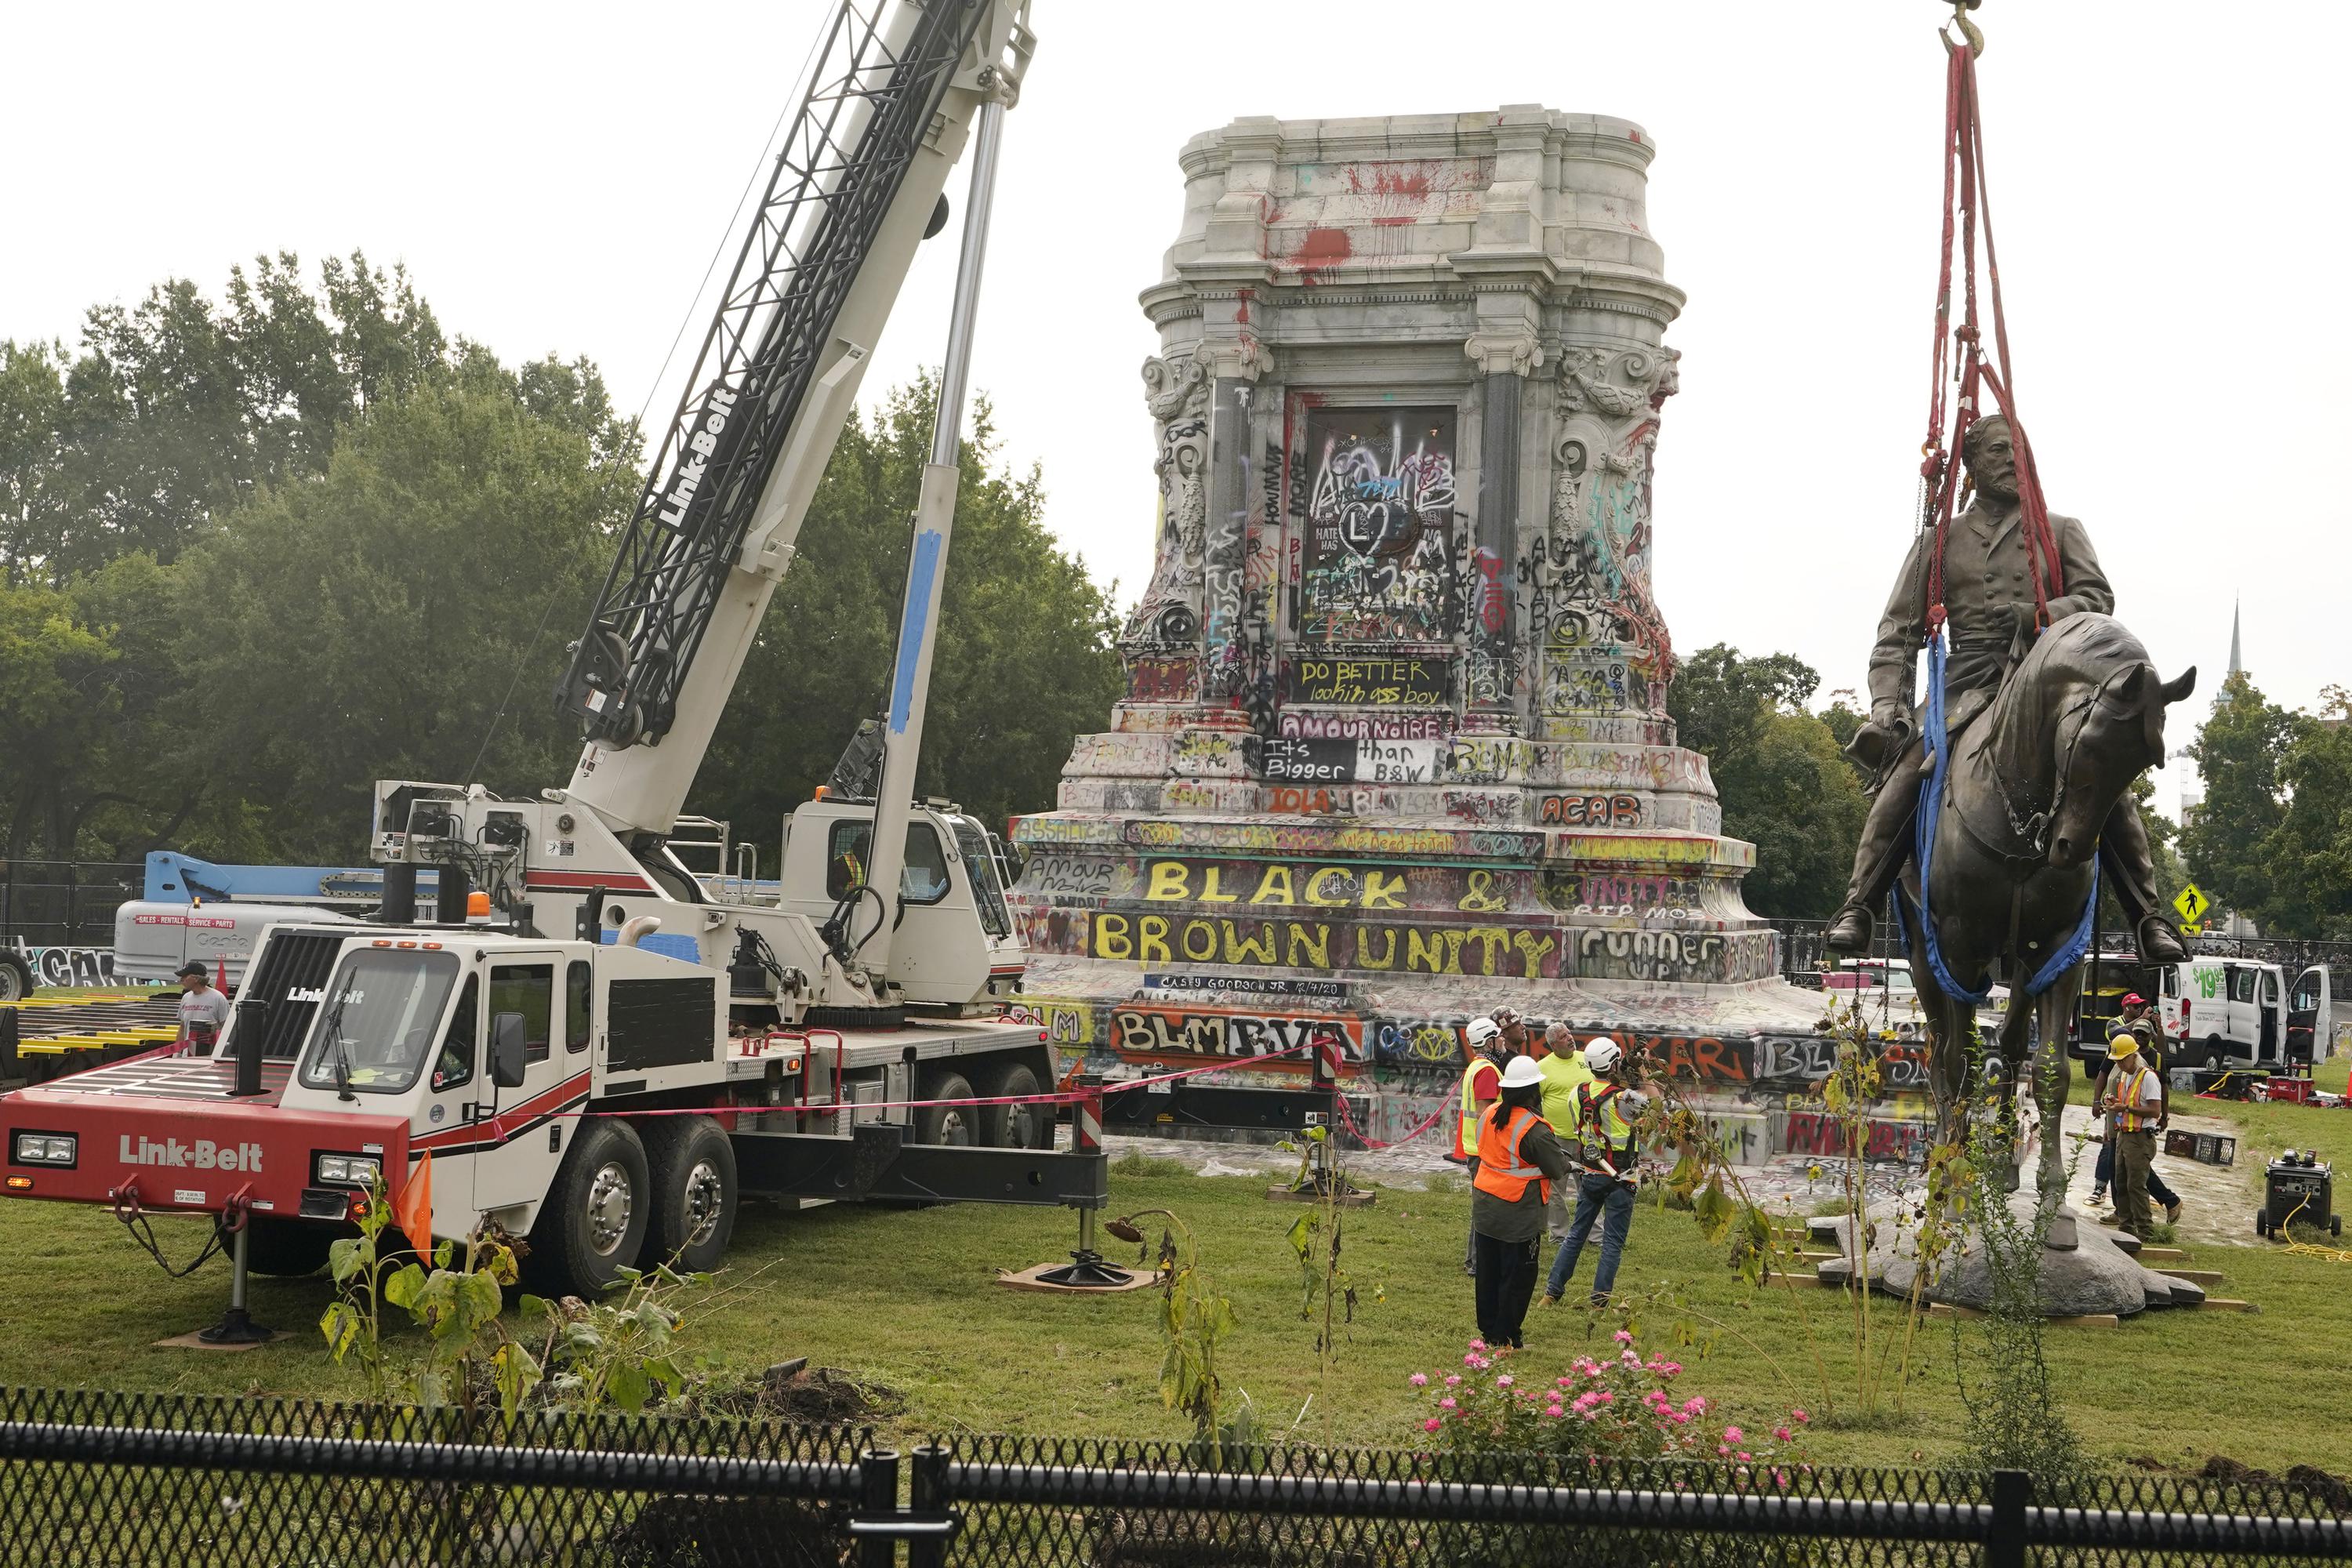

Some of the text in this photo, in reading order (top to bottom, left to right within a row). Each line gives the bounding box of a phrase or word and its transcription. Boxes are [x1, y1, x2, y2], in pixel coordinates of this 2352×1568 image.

[658, 387, 739, 528] Link-Belt
[1316, 528, 1338, 540] HATE
[1321, 539, 1338, 550] HAS
[1301, 660, 1430, 684] DO BETTER
[1370, 687, 1401, 704] ass
[1403, 683, 1440, 706] boy
[1280, 714, 1371, 739] AMOUR
[1264, 738, 1310, 757] It's
[1359, 740, 1414, 764] than
[1265, 757, 1345, 779] Bigger
[1374, 763, 1426, 782] B&W
[1267, 786, 1330, 813] IOLA
[1541, 796, 1641, 829] ACAB
[1341, 833, 1367, 850] We
[1410, 835, 1428, 850] to
[1029, 858, 1115, 883] AMOUR
[1145, 861, 1507, 913] BLACK &
[1581, 875, 1670, 904] UNITY
[1573, 904, 1634, 918] RIP
[188, 919, 211, 927] SERVICE
[216, 920, 233, 928] PARTS
[1094, 913, 1555, 978] BROWN UNITY
[1160, 977, 1201, 989] CASEY
[1117, 1011, 1228, 1055] BLM
[1231, 1018, 1363, 1062] RVA
[118, 1134, 264, 1173] Link-Belt
